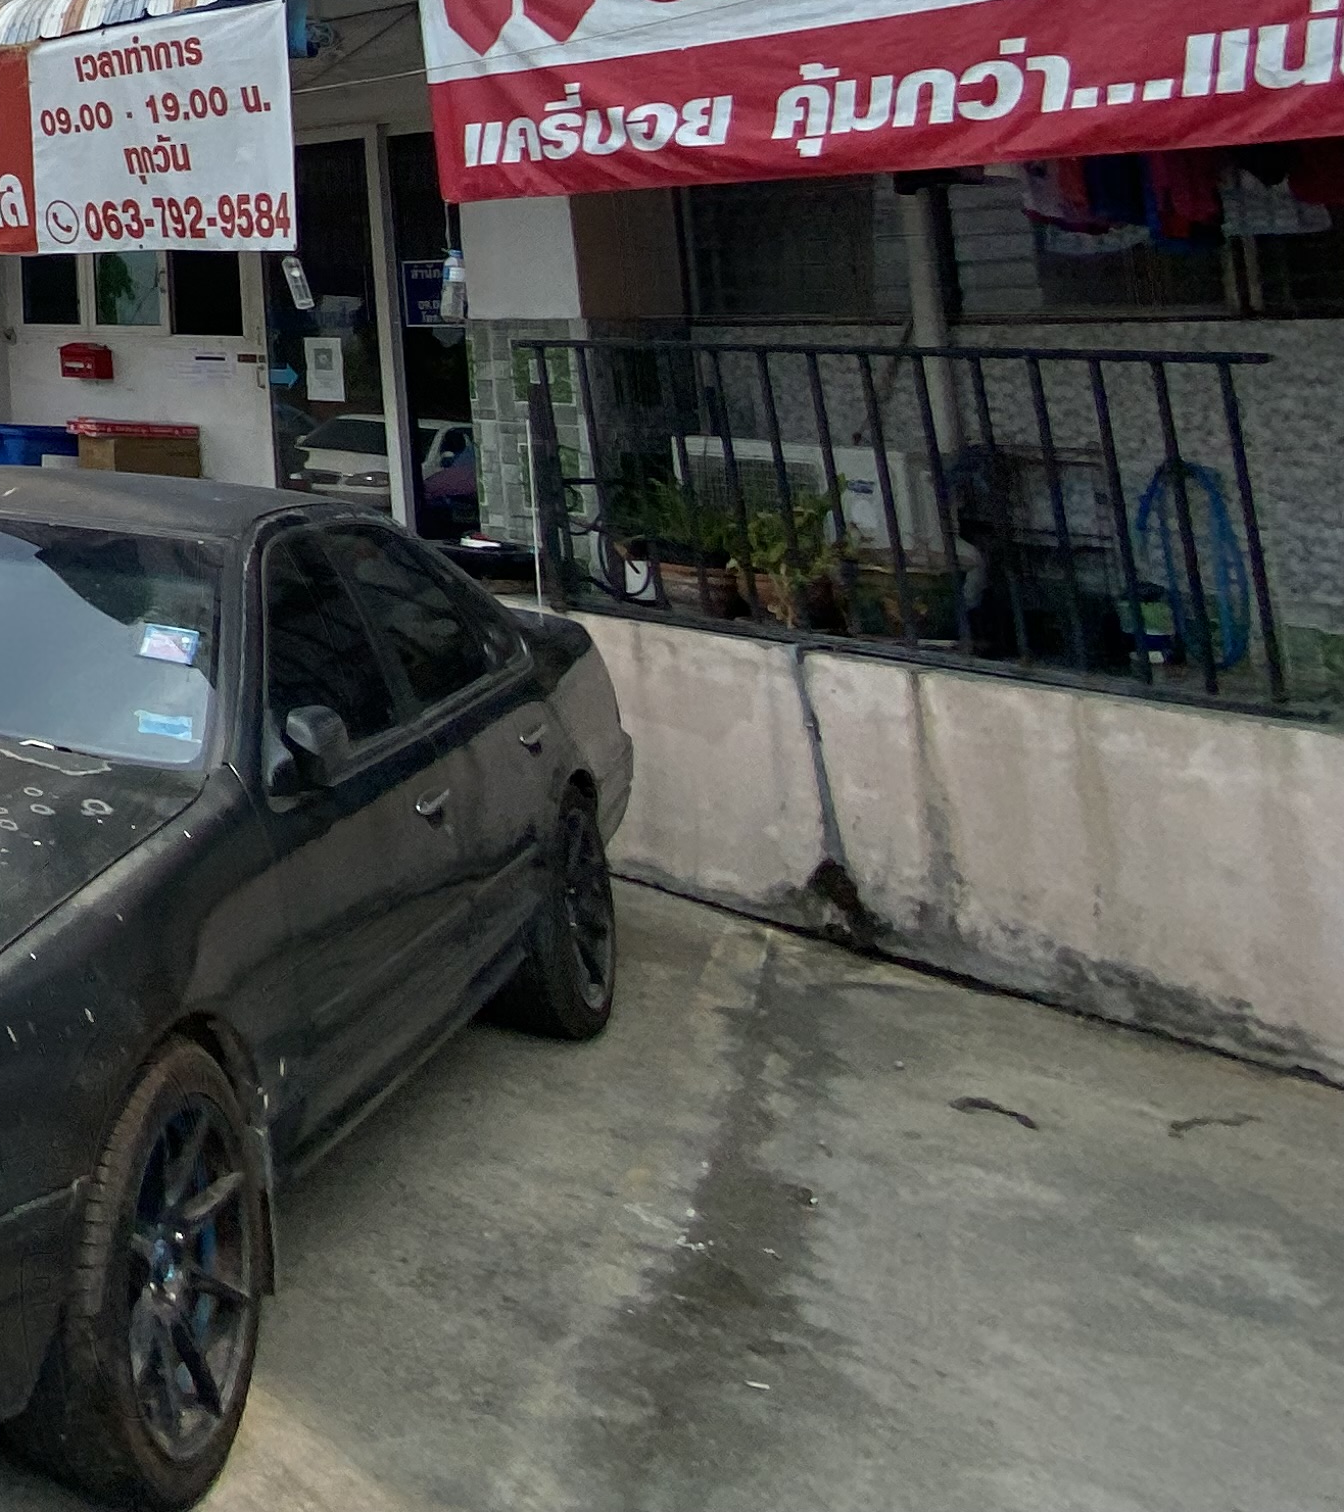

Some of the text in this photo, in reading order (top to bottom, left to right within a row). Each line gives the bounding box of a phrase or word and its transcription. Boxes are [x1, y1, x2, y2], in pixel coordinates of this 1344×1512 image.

[74, 35, 204, 82] เวลาทำการ
[40, 101, 113, 136] 09.00
[145, 85, 228, 124] 19.00
[241, 85, 272, 113] น.
[464, 83, 733, 168] แครี่บอย
[123, 134, 192, 185] ทุกวัน
[85, 192, 291, 241] 063-792-9584
